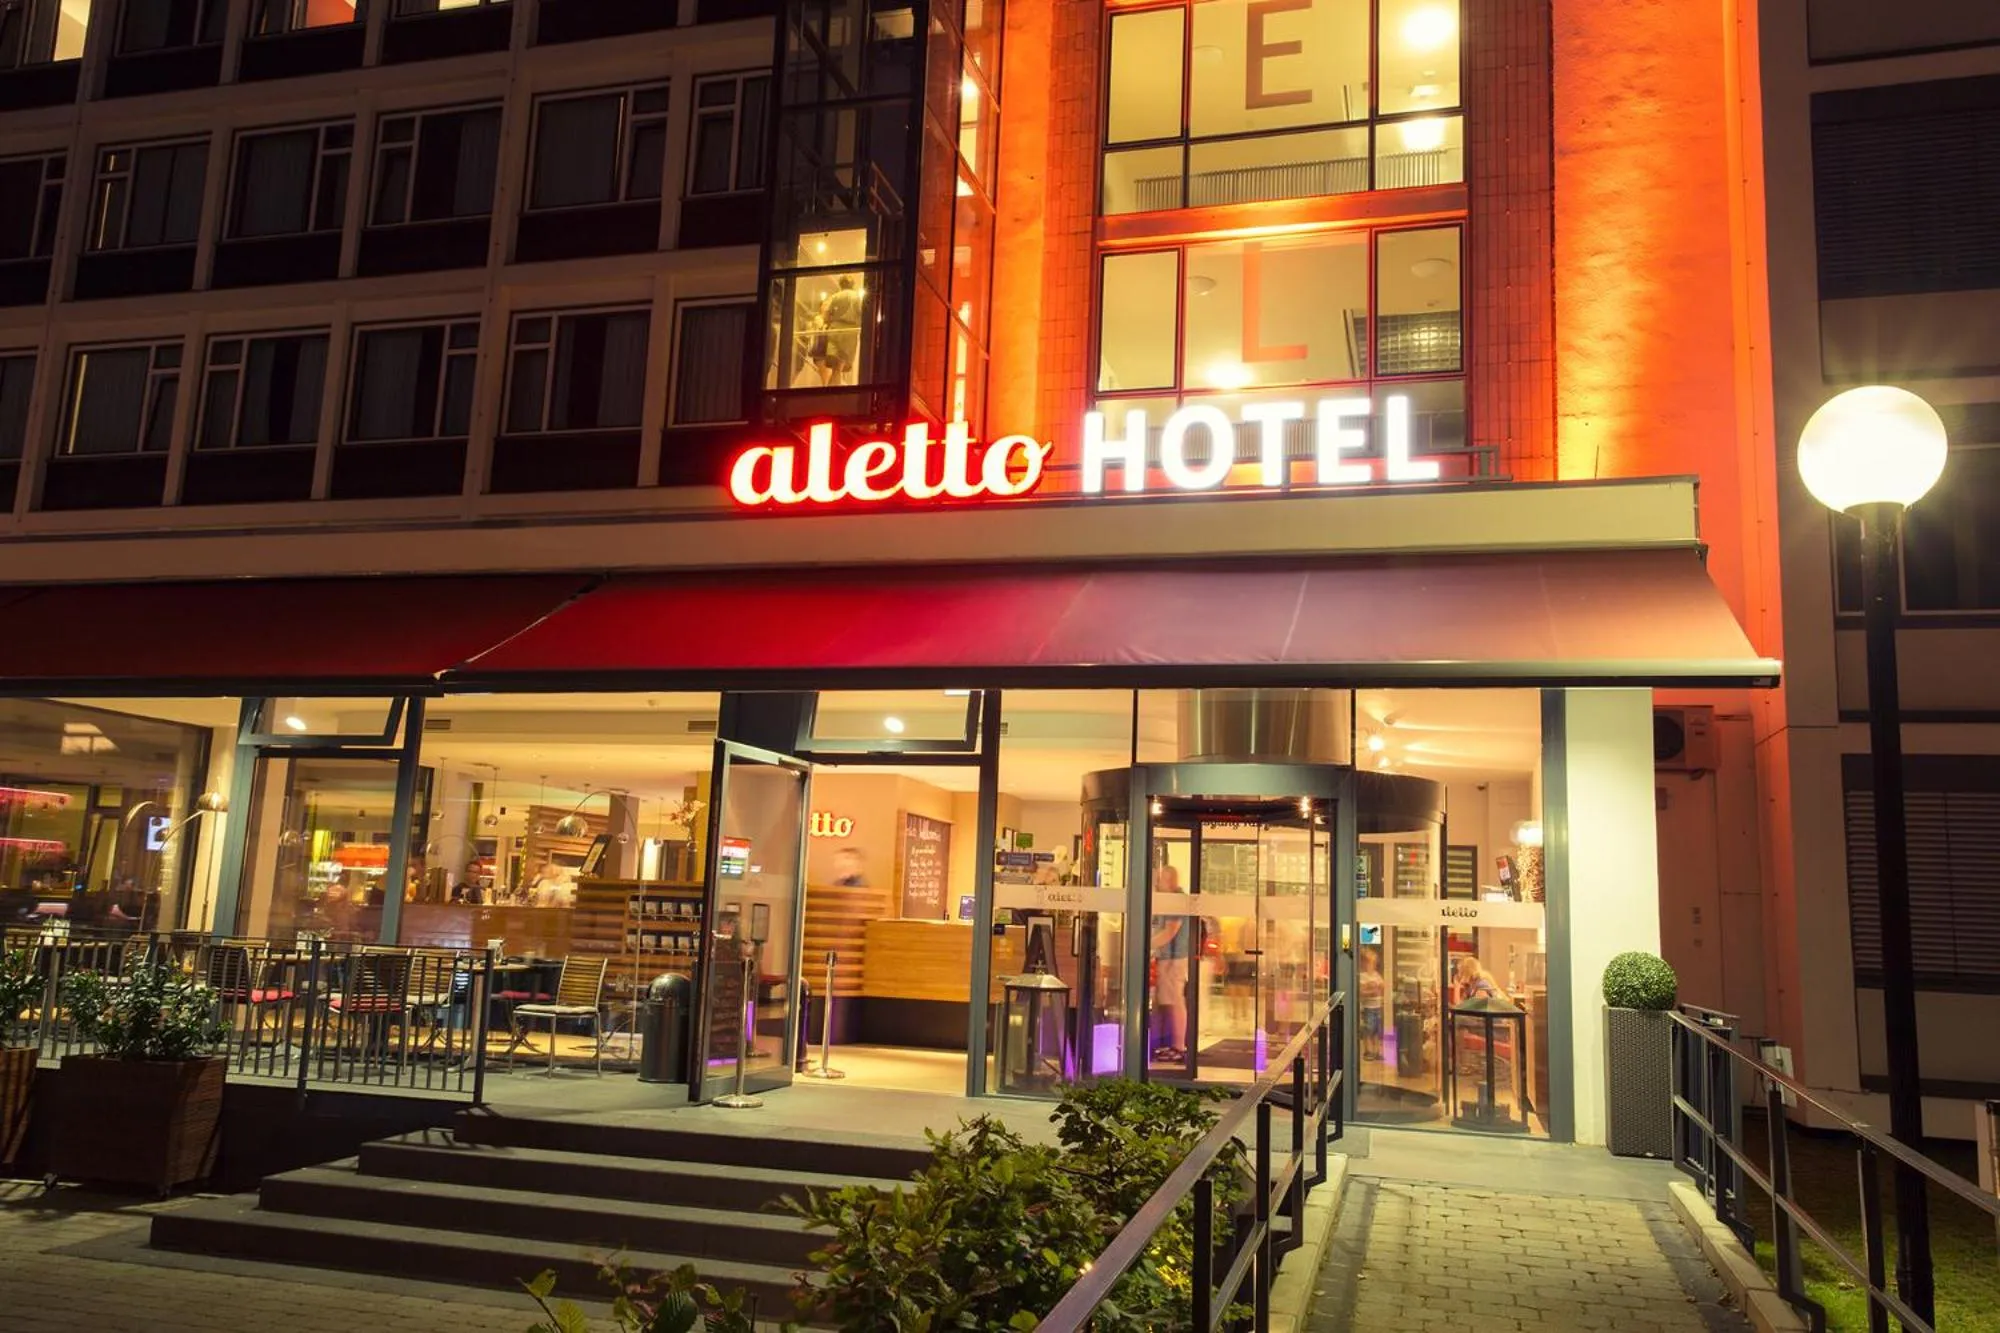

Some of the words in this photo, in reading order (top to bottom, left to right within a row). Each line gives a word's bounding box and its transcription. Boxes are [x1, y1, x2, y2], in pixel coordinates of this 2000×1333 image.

[729, 421, 1053, 505] aletto
[1082, 395, 1440, 493] HOTEL
[809, 811, 854, 838] tto
